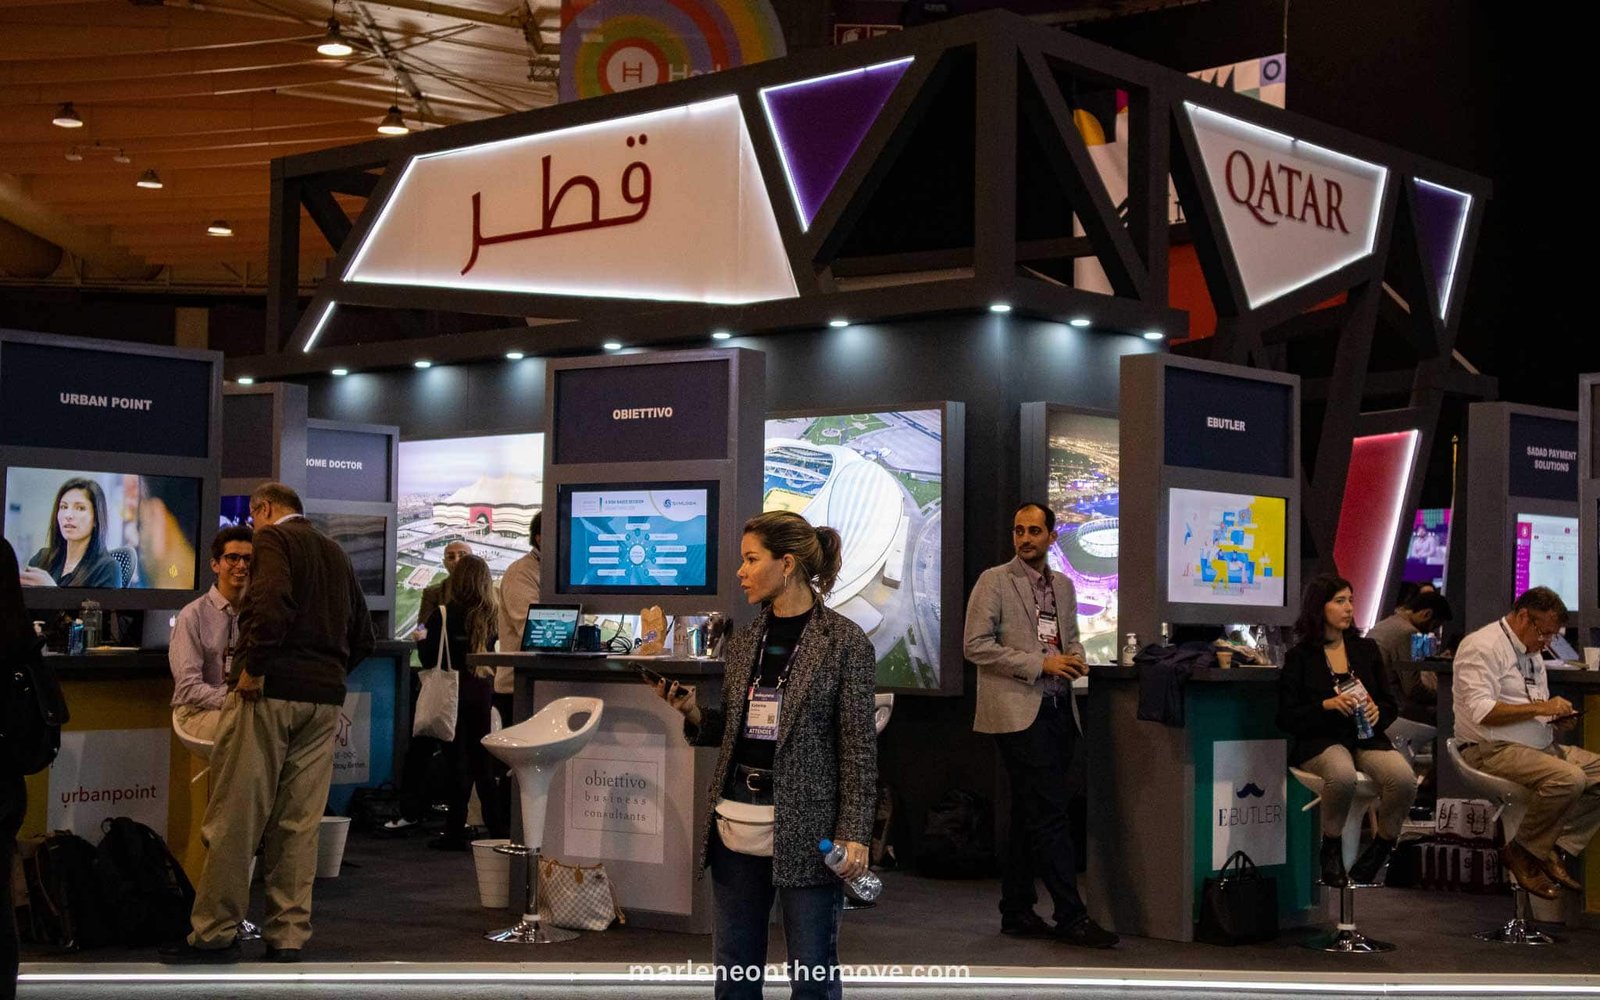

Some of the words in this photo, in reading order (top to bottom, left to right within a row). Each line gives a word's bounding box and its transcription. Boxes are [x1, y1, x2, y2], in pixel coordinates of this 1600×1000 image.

[1225, 149, 1350, 234] QATAR
[461, 133, 651, 276] قطر
[59, 392, 108, 408] URBAN
[111, 396, 153, 411] POINT
[612, 406, 673, 420] OBIETTIVO
[1206, 416, 1246, 432] EBUTLER
[1526, 446, 1548, 457] SADAD
[1548, 448, 1577, 461] PAYMENT
[328, 459, 363, 470] DOCTOR
[1534, 459, 1570, 472] SOLUTIONS
[585, 769, 646, 789] obiettivo
[61, 784, 157, 808] urbanpoint
[584, 790, 647, 806] business
[584, 808, 647, 822] consultants
